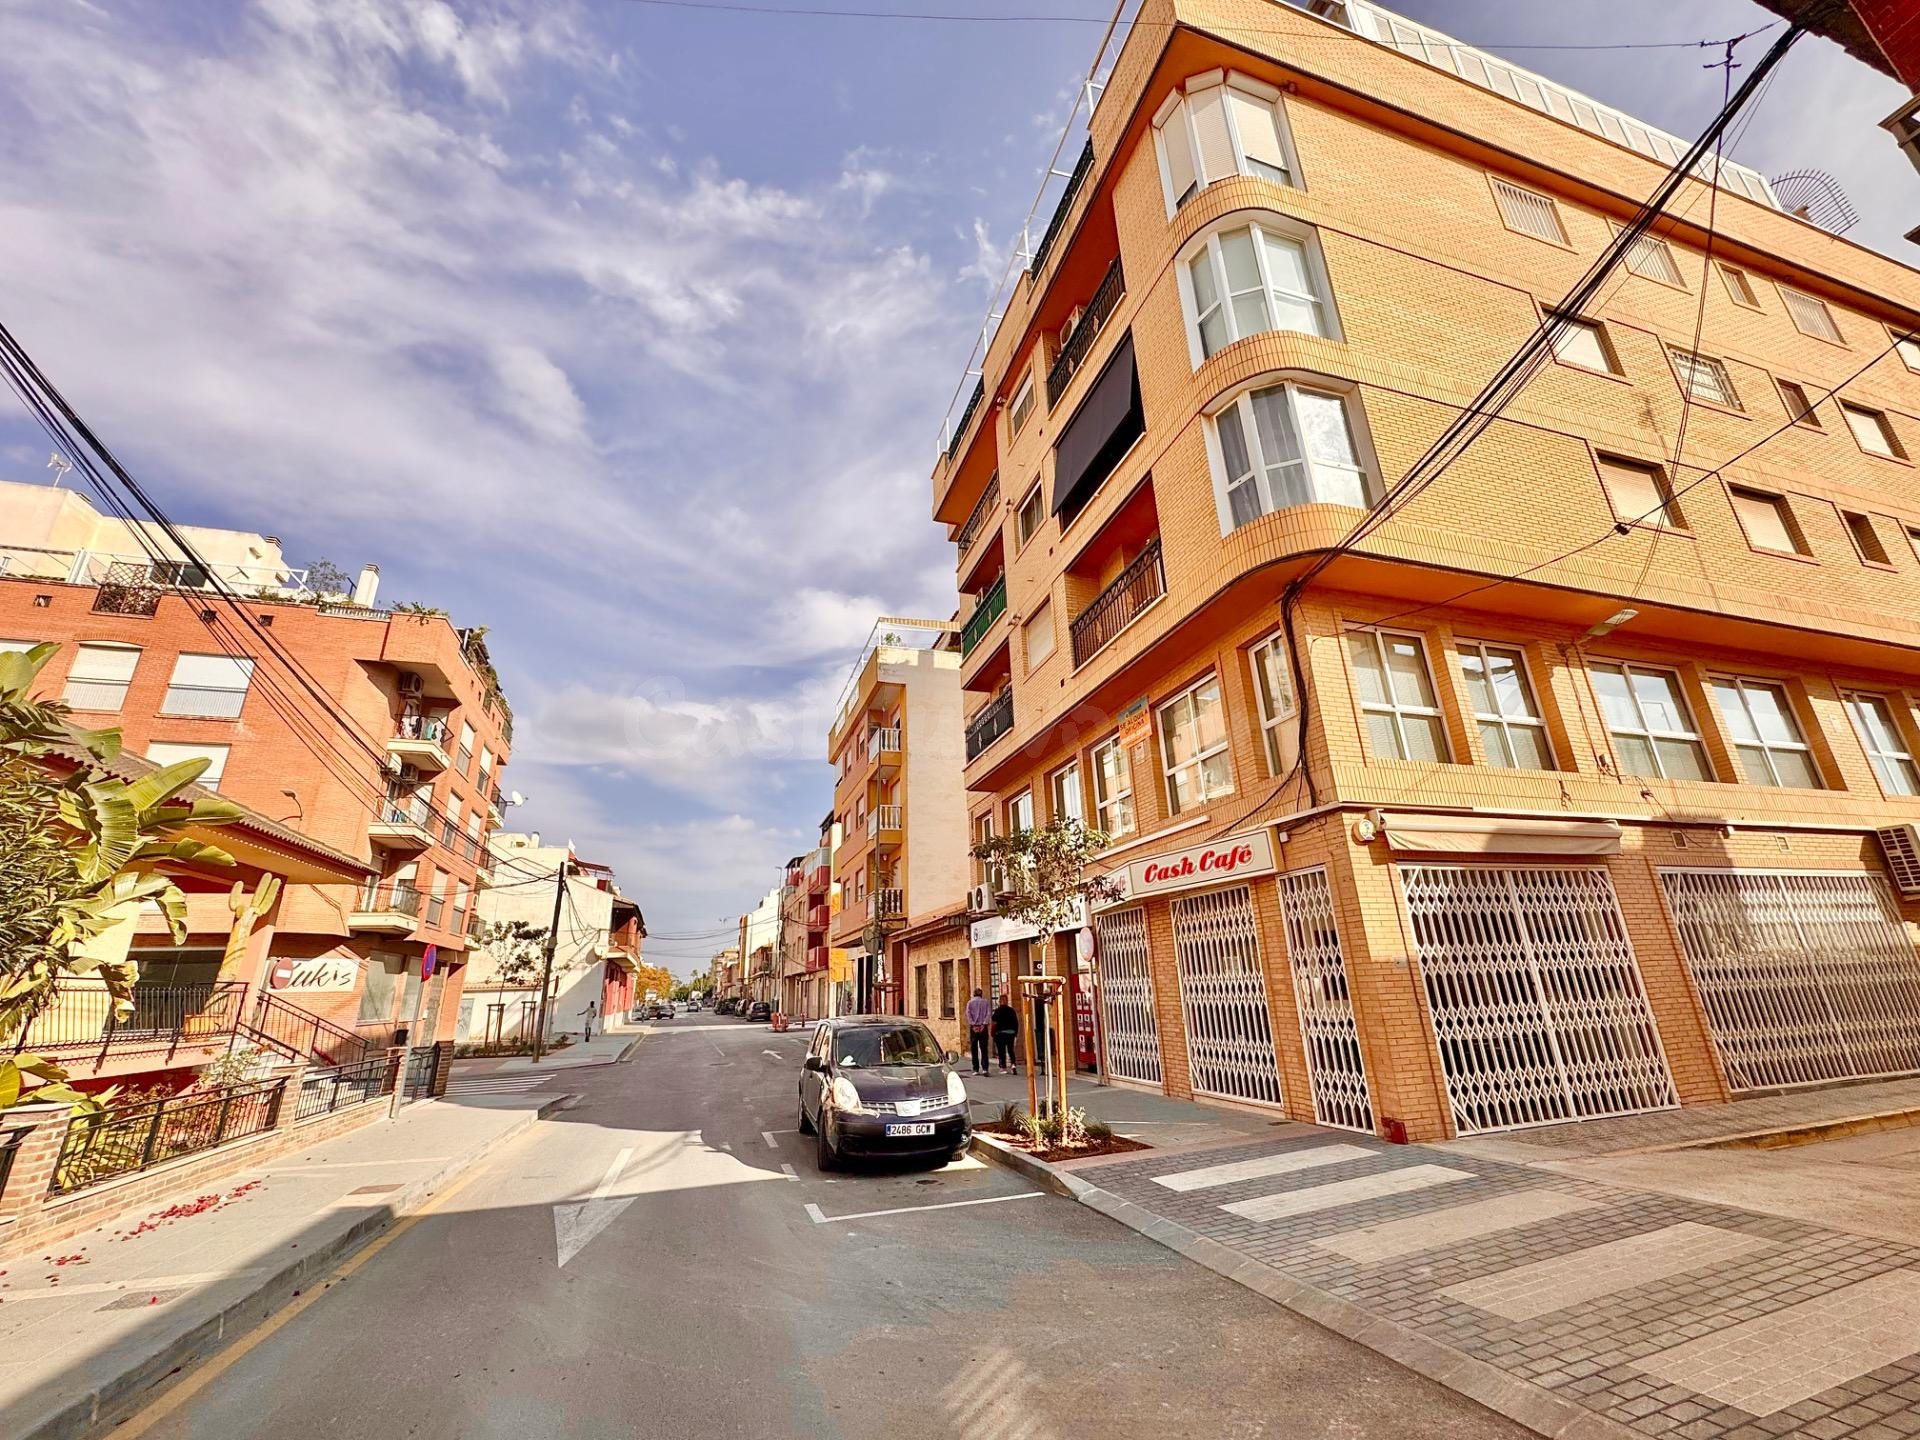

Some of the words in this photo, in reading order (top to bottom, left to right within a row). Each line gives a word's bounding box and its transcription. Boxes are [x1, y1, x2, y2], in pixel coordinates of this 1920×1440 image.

[1144, 856, 1197, 883] Cash
[1199, 843, 1253, 872] Café
[891, 1125, 912, 1135] 2486
